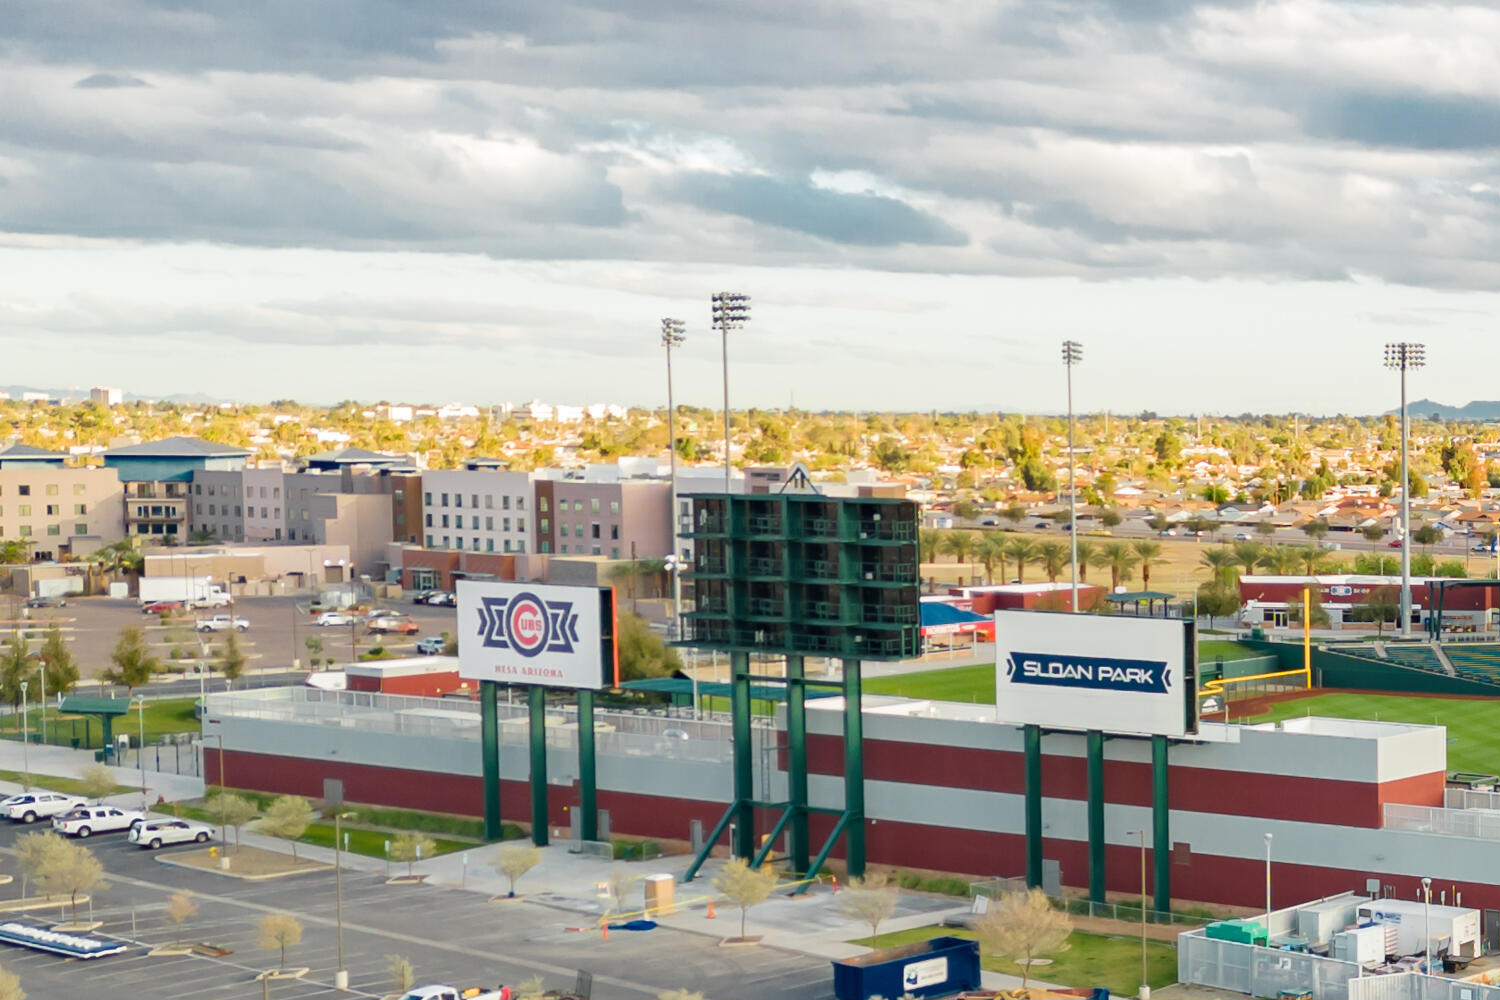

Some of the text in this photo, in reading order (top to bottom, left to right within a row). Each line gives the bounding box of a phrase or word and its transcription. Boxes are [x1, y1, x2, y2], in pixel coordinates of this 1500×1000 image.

[512, 603, 543, 646] CUBS
[494, 664, 564, 679] MESA ARIZONA
[1023, 660, 1154, 685] SLOAN PARK
